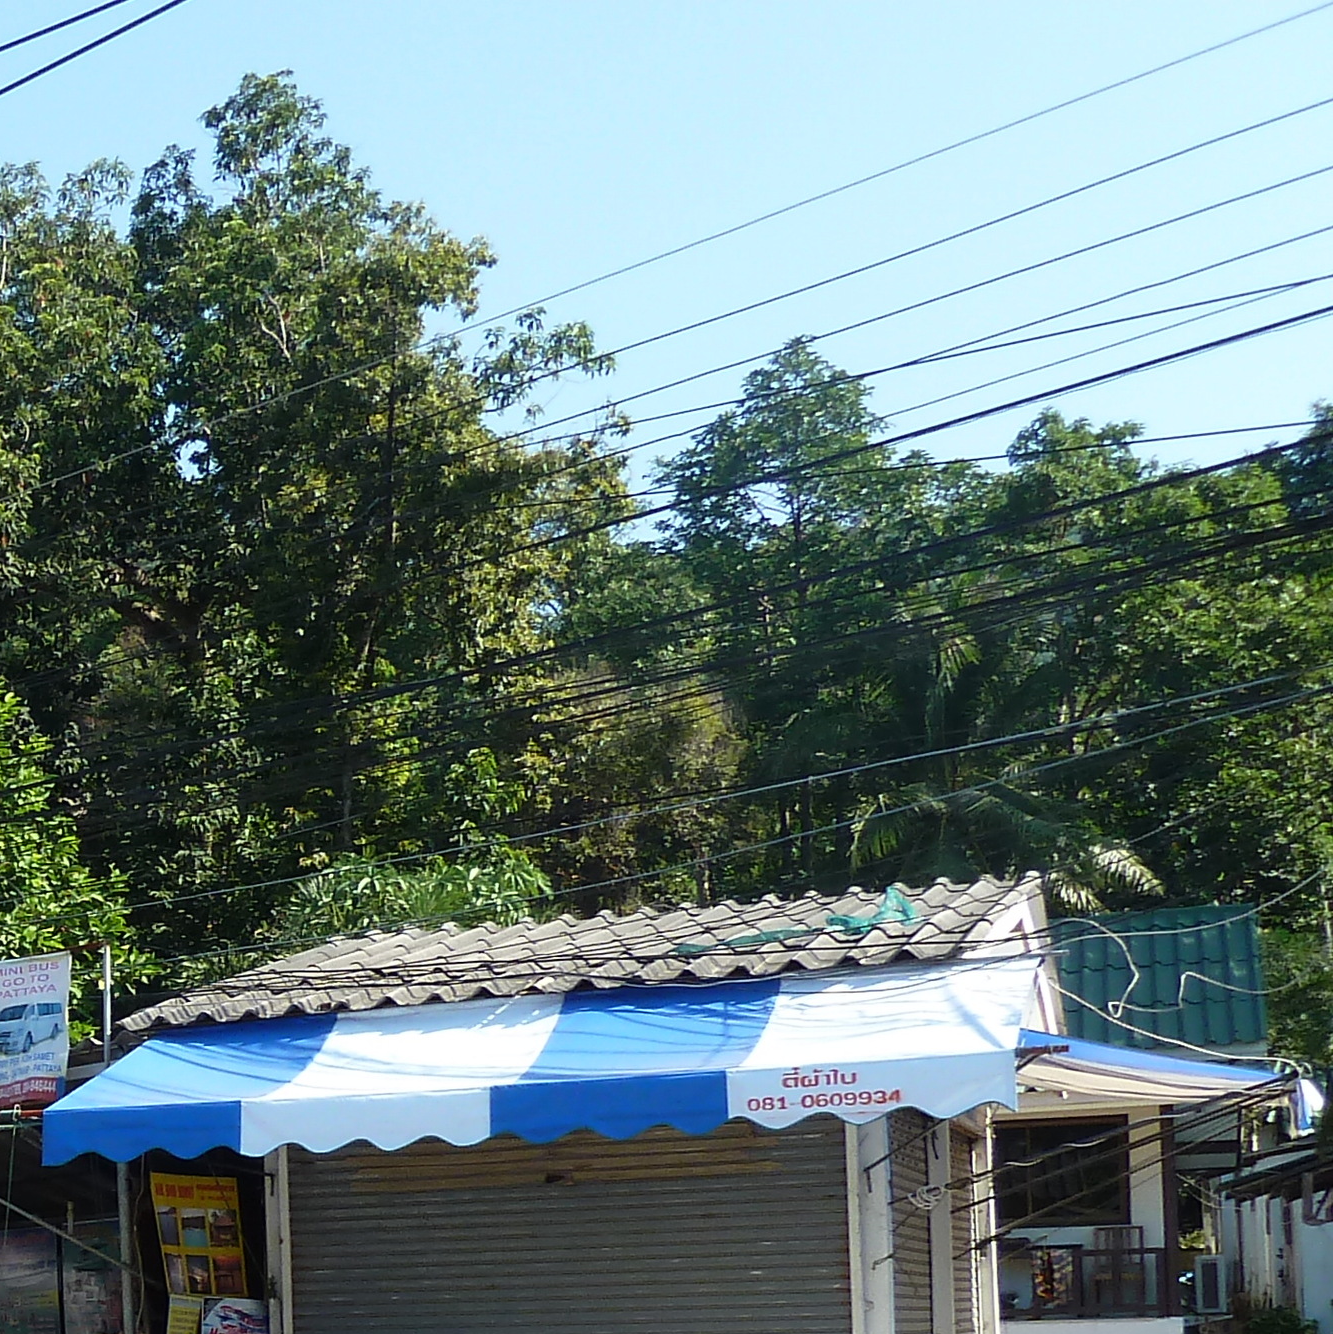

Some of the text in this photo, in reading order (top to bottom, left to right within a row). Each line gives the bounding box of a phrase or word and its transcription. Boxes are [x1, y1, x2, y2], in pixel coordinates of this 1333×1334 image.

[28, 962, 60, 973] BUS
[2, 974, 49, 988] GO TO
[747, 1089, 904, 1112] 081-0609934
